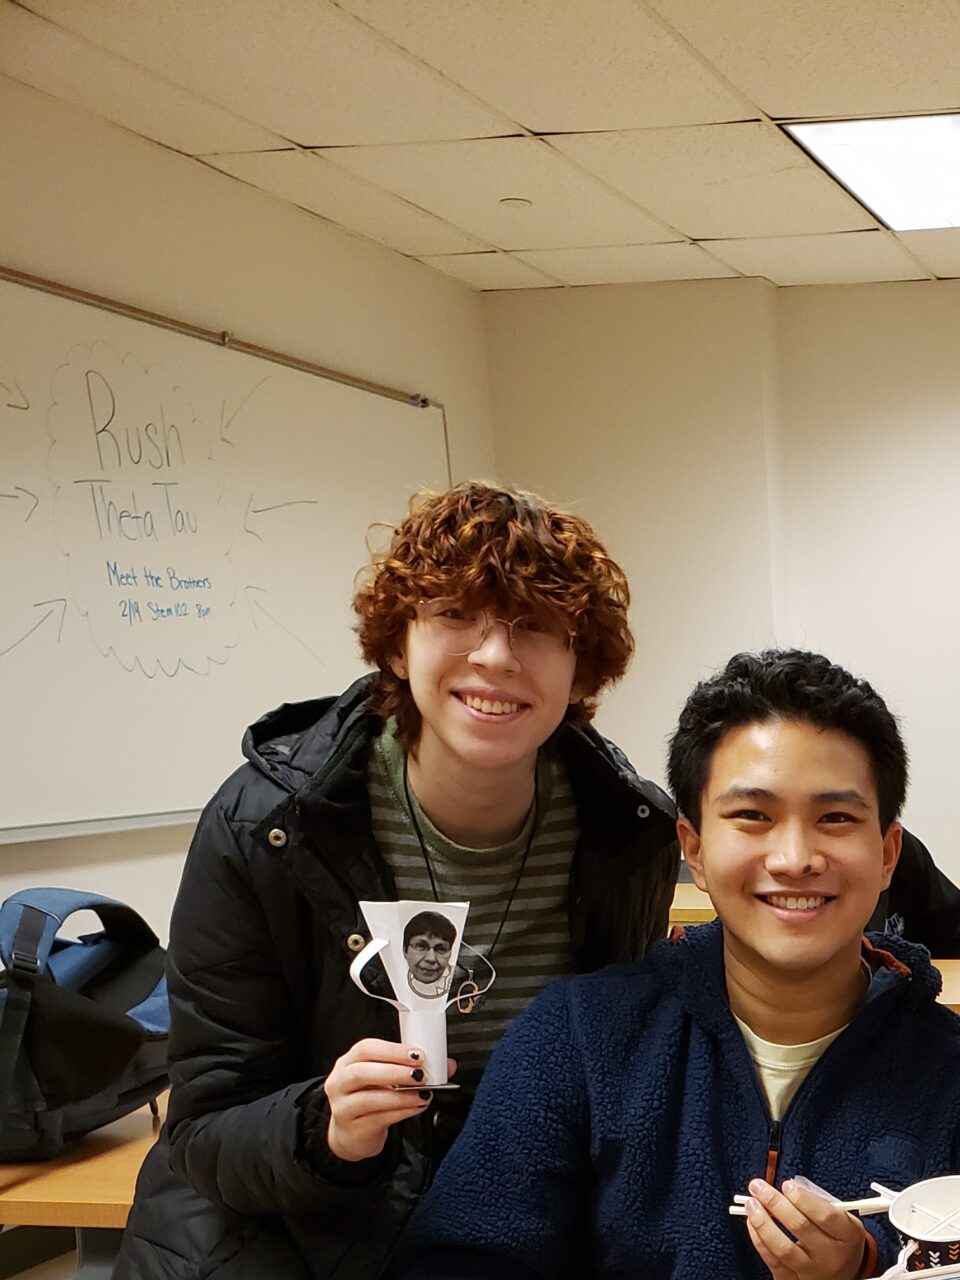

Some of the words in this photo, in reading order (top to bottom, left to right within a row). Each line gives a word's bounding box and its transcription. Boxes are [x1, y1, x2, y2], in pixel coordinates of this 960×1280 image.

[86, 370, 186, 471] Rush
[74, 480, 158, 542] Theta
[152, 482, 198, 537] Tau
[106, 560, 138, 587] Meet
[143, 566, 164, 588] the
